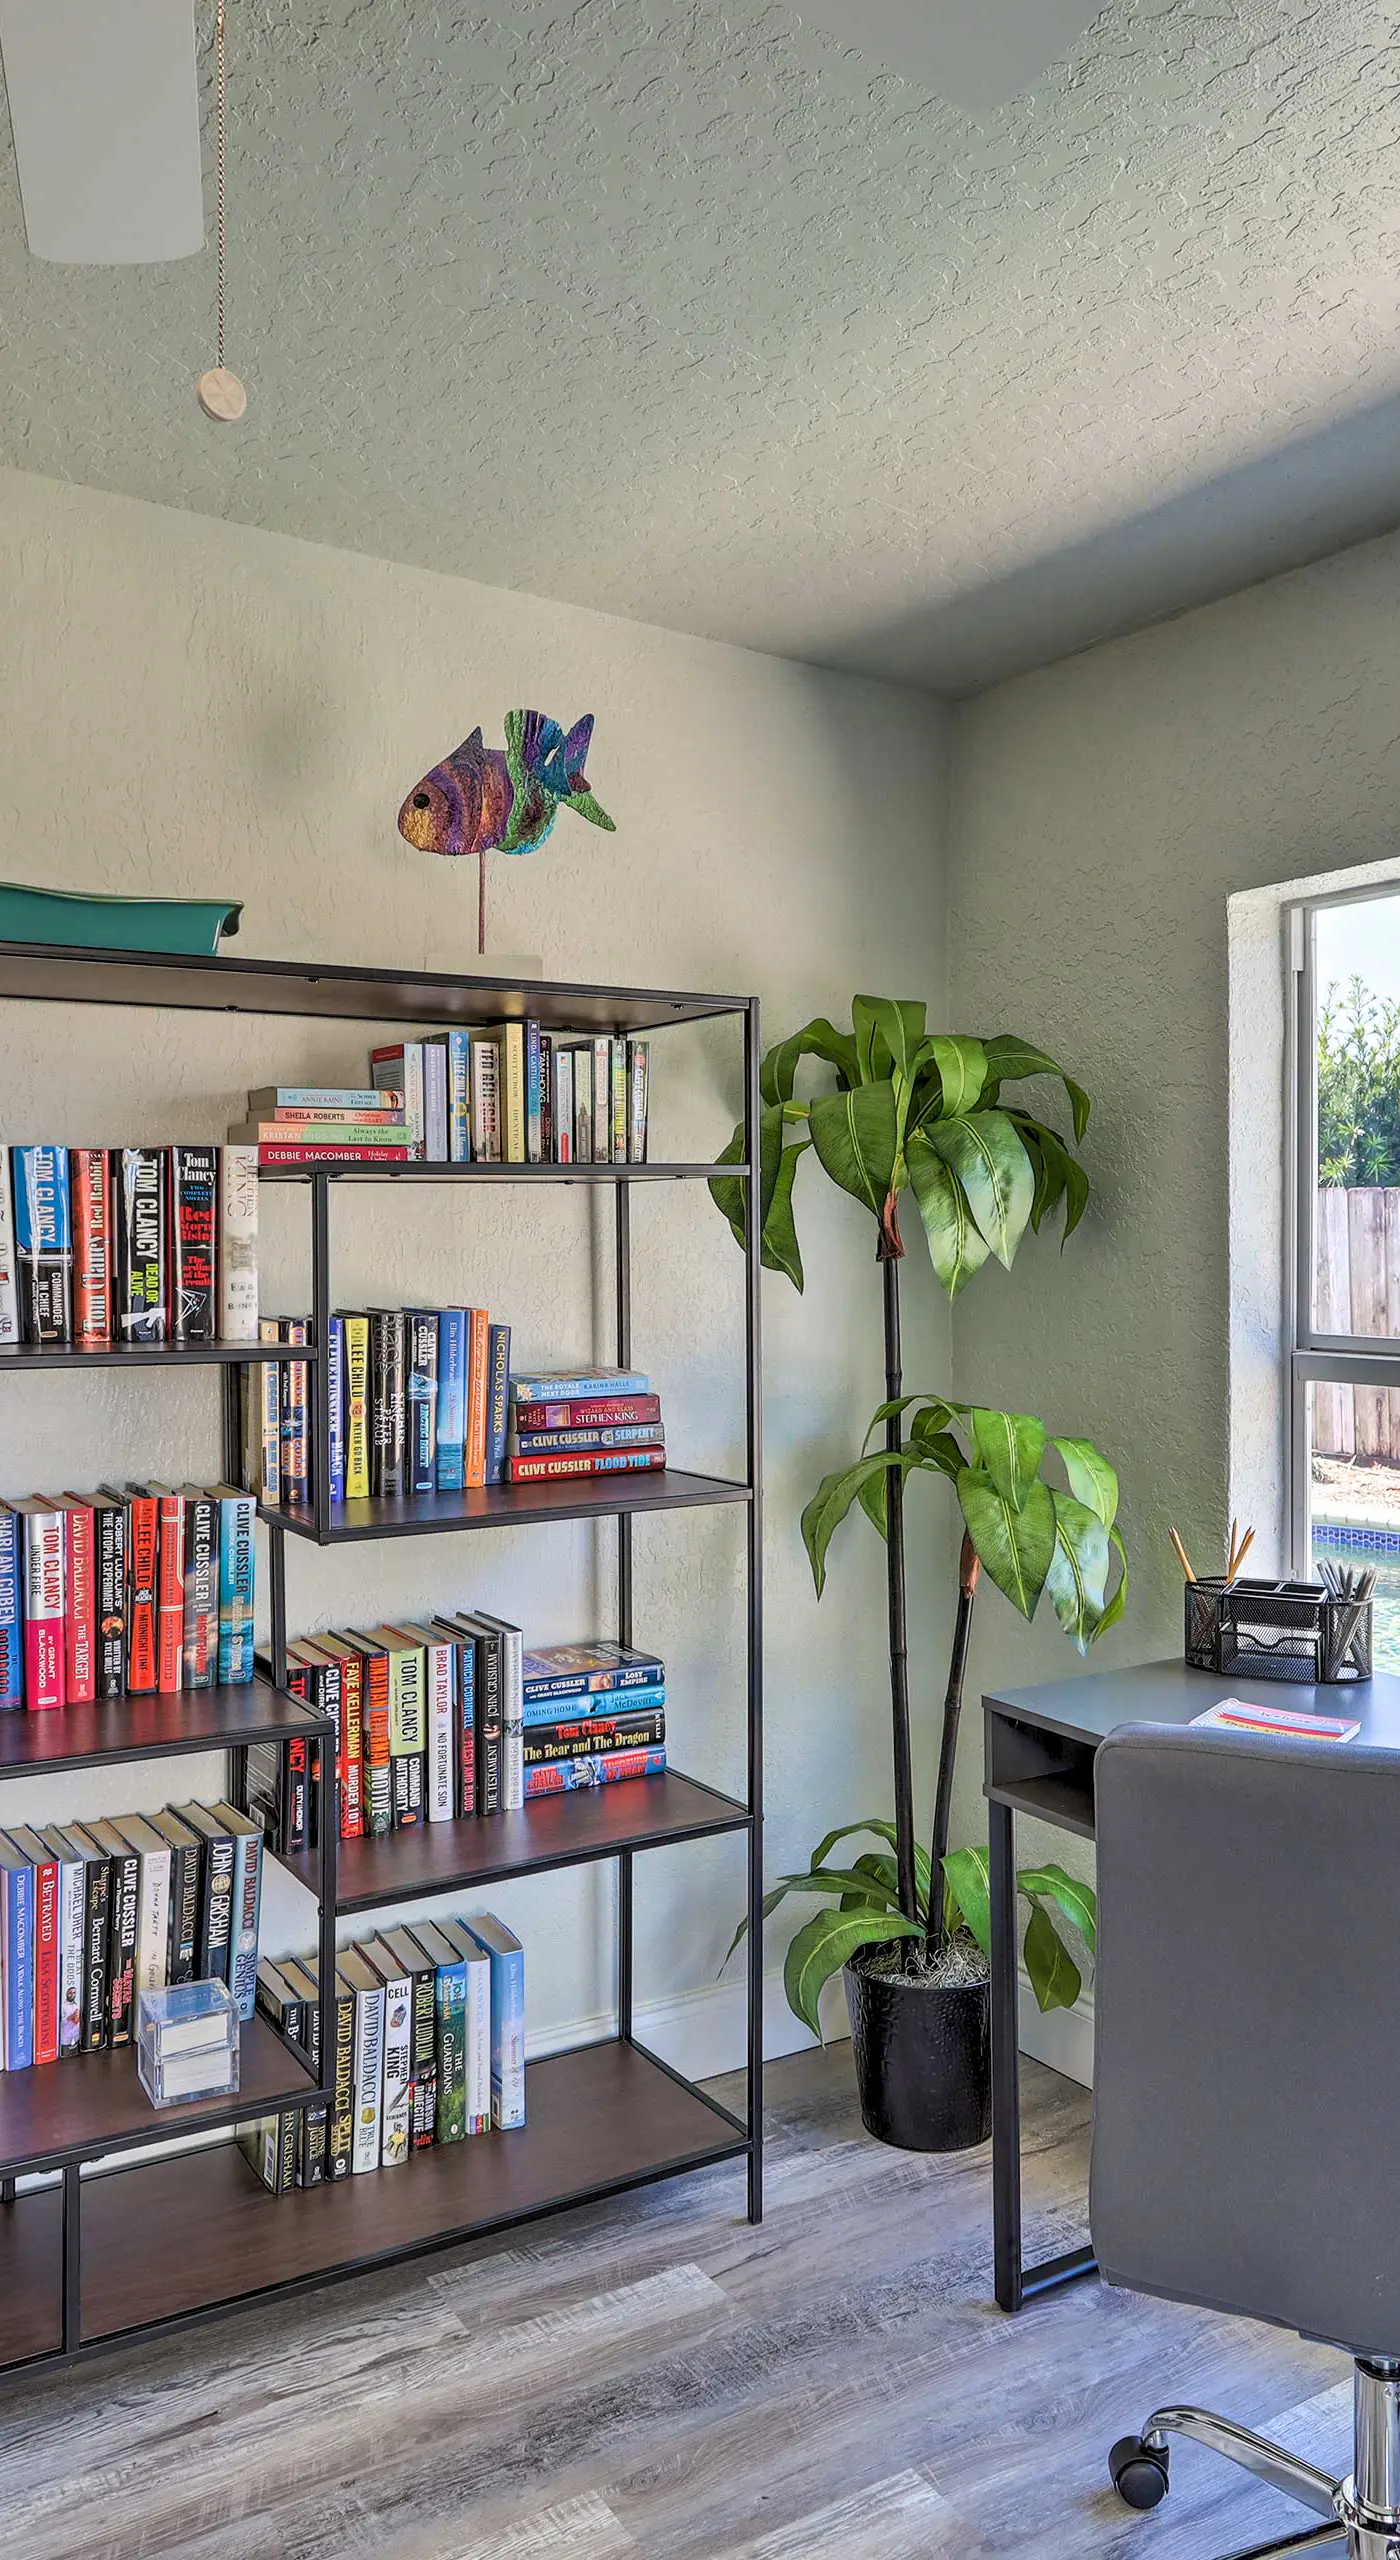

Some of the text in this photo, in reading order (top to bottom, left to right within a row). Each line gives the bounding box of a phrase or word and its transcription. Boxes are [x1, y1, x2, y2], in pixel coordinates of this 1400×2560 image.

[184, 1153, 208, 1167] Tom
[268, 1151, 361, 1160] DEBBIE MACOMBER
[36, 1151, 56, 1242] TOM CLANCY
[135, 1159, 158, 1259] TOM CLANCY
[82, 1161, 105, 1331] Tom Clancy Red Rabbit
[39, 1281, 50, 1318] IN CHIEF
[52, 1272, 61, 1326] COMMANDER
[131, 1271, 143, 1296] ALIVE
[146, 1264, 159, 1303] DEAD OR
[352, 1343, 364, 1397] LEE CHILD
[418, 1325, 428, 1366] CUSSLER
[428, 1332, 436, 1360] CLIVE
[449, 1322, 457, 1386] Elin Hilderbrand
[390, 1393, 398, 1422] KING
[493, 1331, 505, 1433] NICHOLAS SPARKS
[374, 1398, 384, 1445] STRAUB
[382, 1408, 391, 1444] PETER
[397, 1392, 405, 1444] STEPHEN
[532, 1432, 599, 1446] CLIVE CUSSLER
[576, 1411, 638, 1424] STEPHEN KING
[331, 1442, 343, 1476] BLACK
[354, 1422, 362, 1475] NEVER GO BACK
[519, 1460, 591, 1476] CLIVE CUSSLER
[595, 1455, 651, 1470] FLOOD TIDE
[195, 1505, 210, 1541] CLIVE
[236, 1503, 249, 1593] CLIVE CUSSLER
[30, 1544, 41, 1596] UNDER FIRE
[44, 1526, 60, 1610] TOM CLANCY
[102, 1512, 113, 1613] THE UTOPIA EXPERIMENT
[115, 1516, 123, 1610] ROBERT LUDLUM'S
[137, 1524, 151, 1583] LEE CHILD
[195, 1544, 210, 1600] CUSSLER
[76, 1641, 88, 1680] TARGET
[326, 1669, 339, 1702] CLIVE
[436, 1650, 447, 1714] BRAD TAYLOR
[487, 1654, 499, 1717] JOHN GRISHAM
[525, 1679, 585, 1693] CLIVE CUSSLER
[347, 1662, 359, 1759] FAYE KELLERMAN
[401, 1657, 417, 1742] TOM CLANCY
[464, 1649, 473, 1729] PATRICIA CORNWELL
[523, 1731, 650, 1760] The Bear and The Dragon
[556, 1720, 616, 1739] Tom Clancy
[348, 1765, 359, 1824] MURDER 101
[372, 1769, 389, 1817] MOTIVE
[396, 1758, 407, 1812] AUTHORITY
[409, 1757, 420, 1807] COMMAND
[438, 1732, 447, 1807] NO FORTUNATE SON
[487, 1745, 498, 1809] THE TESTAMENT
[89, 1880, 100, 1910] Escape
[122, 1859, 137, 1948] CLIVE CUSSLER
[181, 1848, 197, 1942] DAVID BALDACCI
[208, 1843, 233, 1949] JOHN GRISHAM
[242, 1840, 259, 1929] DAVID BALDACCI
[16, 1874, 25, 1959] DEBBIE MACOMBER
[41, 1881, 54, 1942] BETRAYED
[67, 1944, 75, 1960] THE
[90, 1917, 104, 2022] Bernard Cornwell
[234, 1954, 245, 1999] GENIUS
[388, 1988, 409, 1999] CELL
[415, 1982, 434, 2062] ROBERT LUDLUM
[335, 2002, 352, 2111] DAVID BALDACCI
[361, 1995, 379, 2105] DAVID BALDACCI
[386, 2047, 399, 2079] KING
[399, 2044, 408, 2086] STEPHEN
[443, 2032, 454, 2095] GUARDIANS
[338, 2115, 351, 2152] SPLIT
[413, 2086, 424, 2133] DIRECTIVE
[308, 2126, 318, 2160] JUSTICE
[317, 2125, 325, 2156] DIVINE
[359, 2128, 367, 2148] BLUE
[367, 2125, 375, 2148] TRUE
